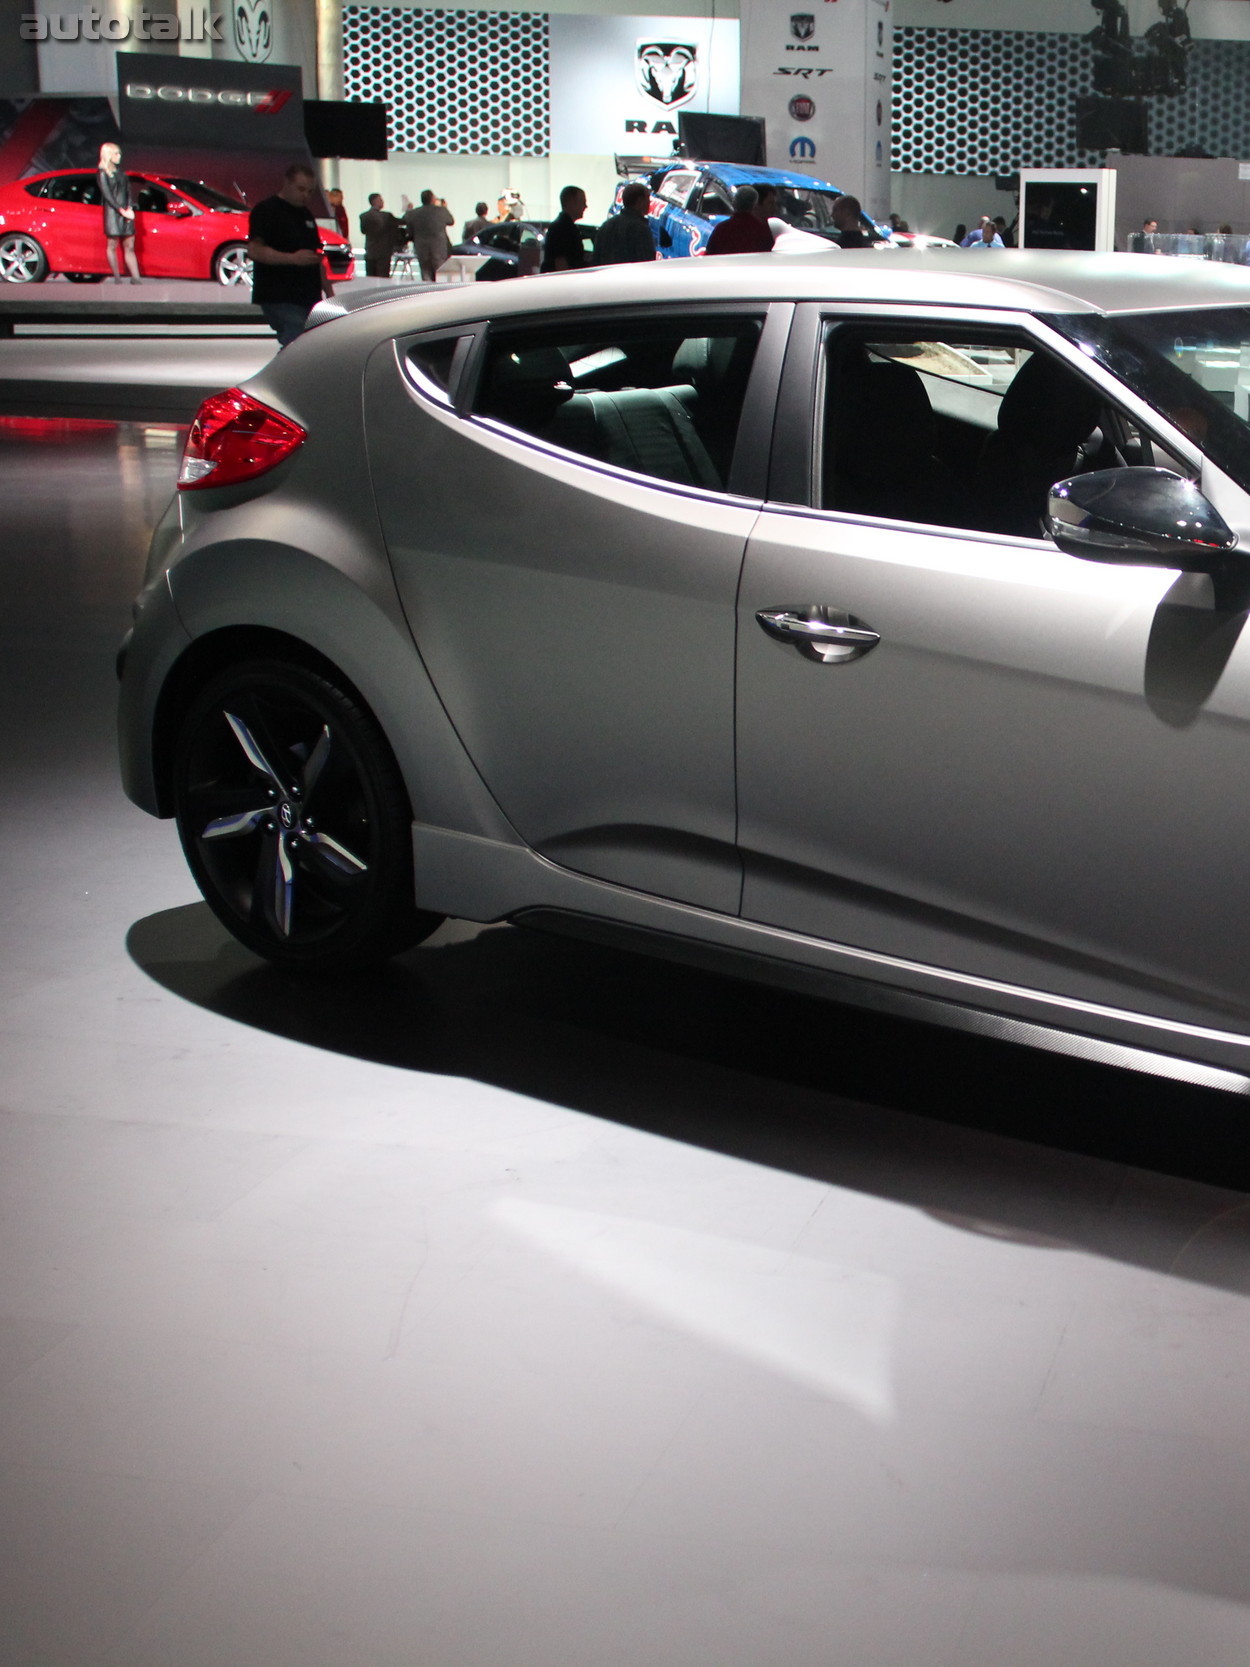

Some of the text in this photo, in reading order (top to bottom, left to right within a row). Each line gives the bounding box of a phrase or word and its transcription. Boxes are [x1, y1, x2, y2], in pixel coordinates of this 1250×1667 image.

[772, 66, 834, 79] SRT
[126, 83, 274, 106] DODGE
[625, 119, 678, 135] RA
